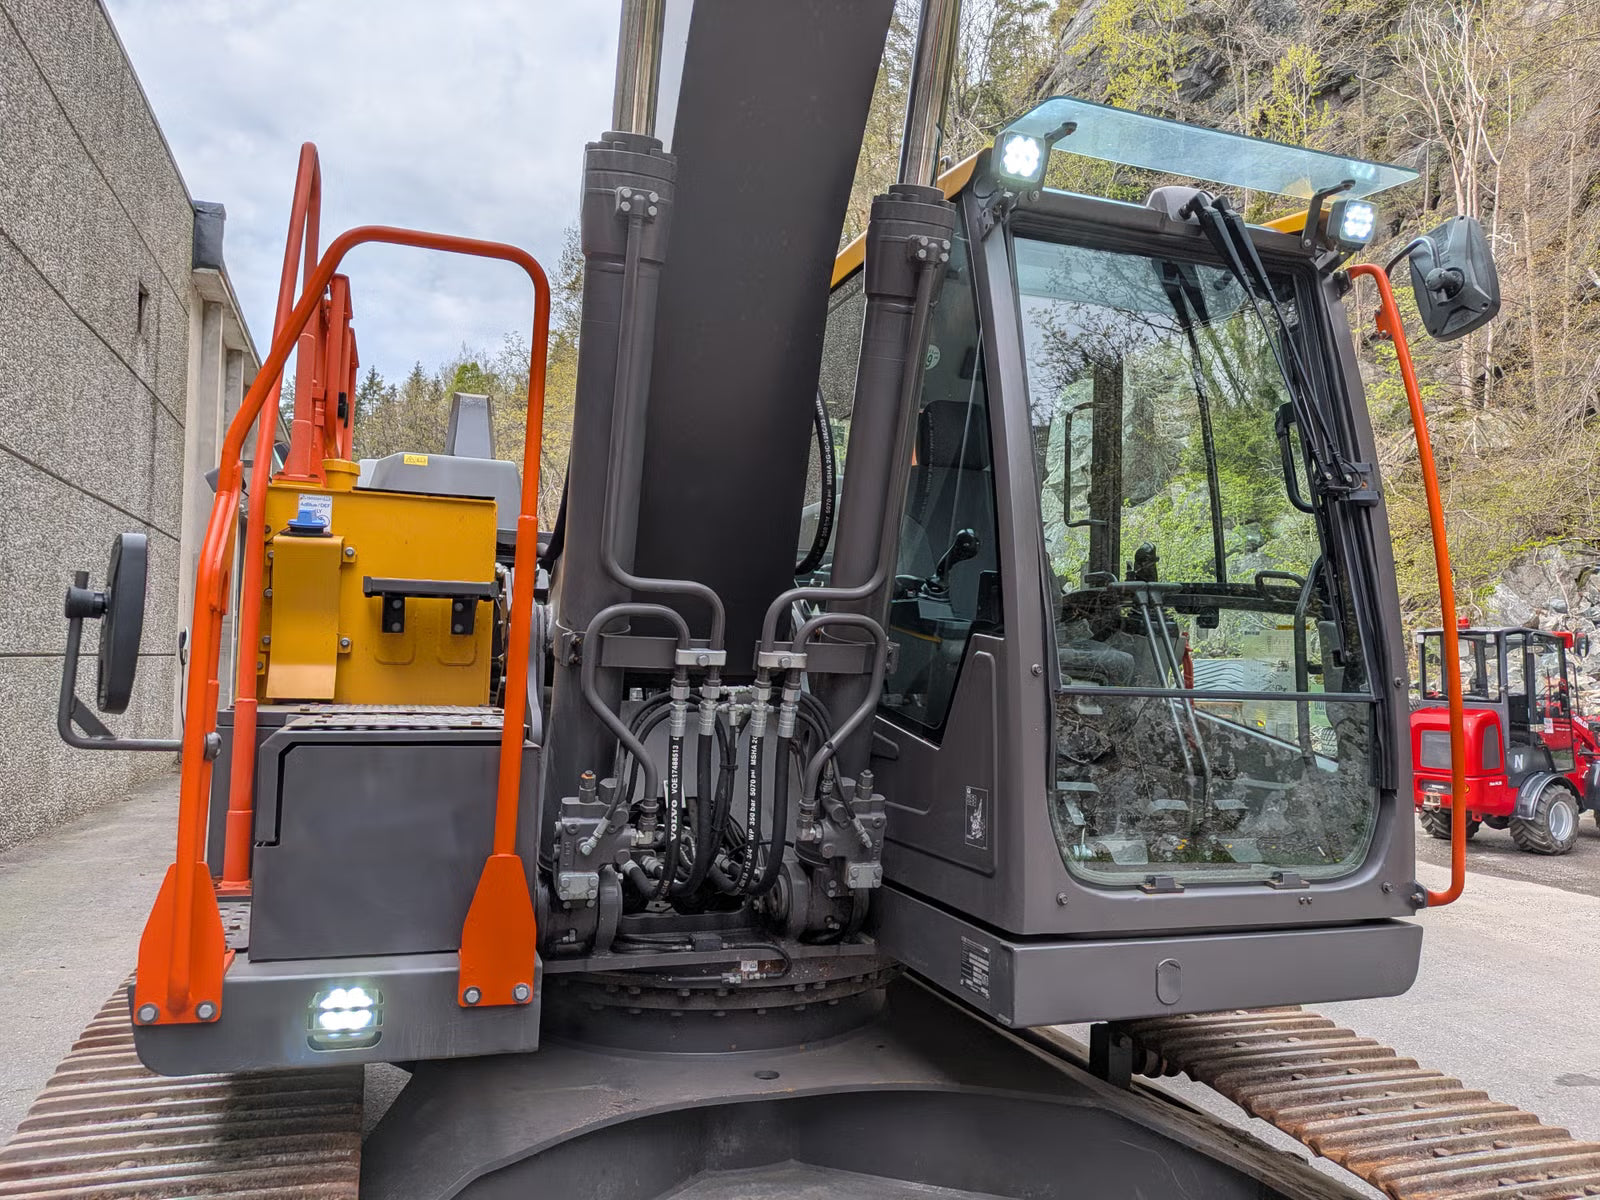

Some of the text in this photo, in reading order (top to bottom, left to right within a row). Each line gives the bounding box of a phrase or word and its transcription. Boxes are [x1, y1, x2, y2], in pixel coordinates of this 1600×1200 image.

[671, 745, 679, 794] VOE17488513
[1514, 754, 1524, 770] N
[670, 800, 678, 841] VOLVO
[748, 828, 755, 841] WP
